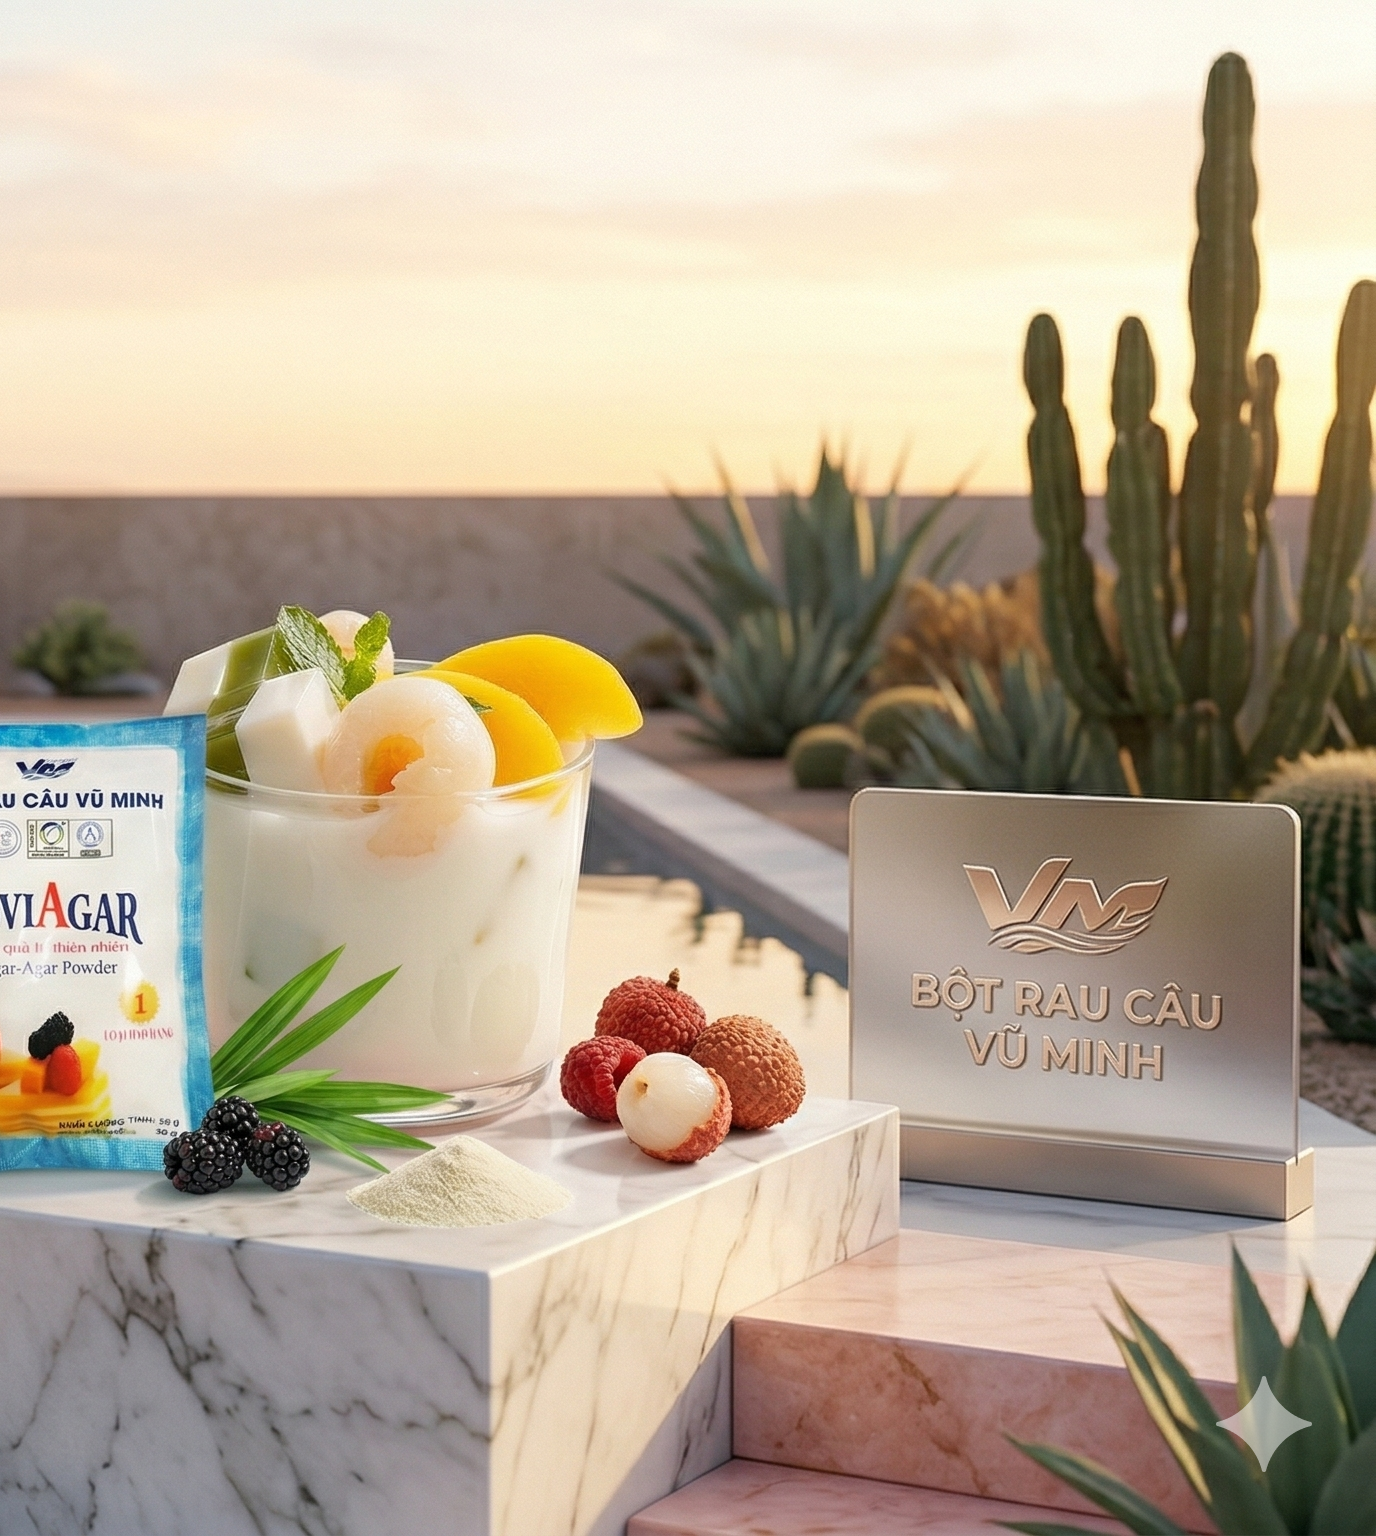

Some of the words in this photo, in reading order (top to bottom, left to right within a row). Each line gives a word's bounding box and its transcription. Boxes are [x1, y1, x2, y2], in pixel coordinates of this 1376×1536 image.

[23, 788, 69, 809] CÂU
[76, 789, 104, 809] VŨ
[111, 792, 164, 810] MINH
[62, 960, 118, 975] Powder
[135, 993, 147, 1015] 1
[910, 965, 1004, 1022] BỘT
[1013, 980, 1111, 1022] RAU
[1123, 981, 1223, 1031] CÂU
[962, 1023, 1027, 1069] VŨ
[1040, 1034, 1165, 1082] MINH
